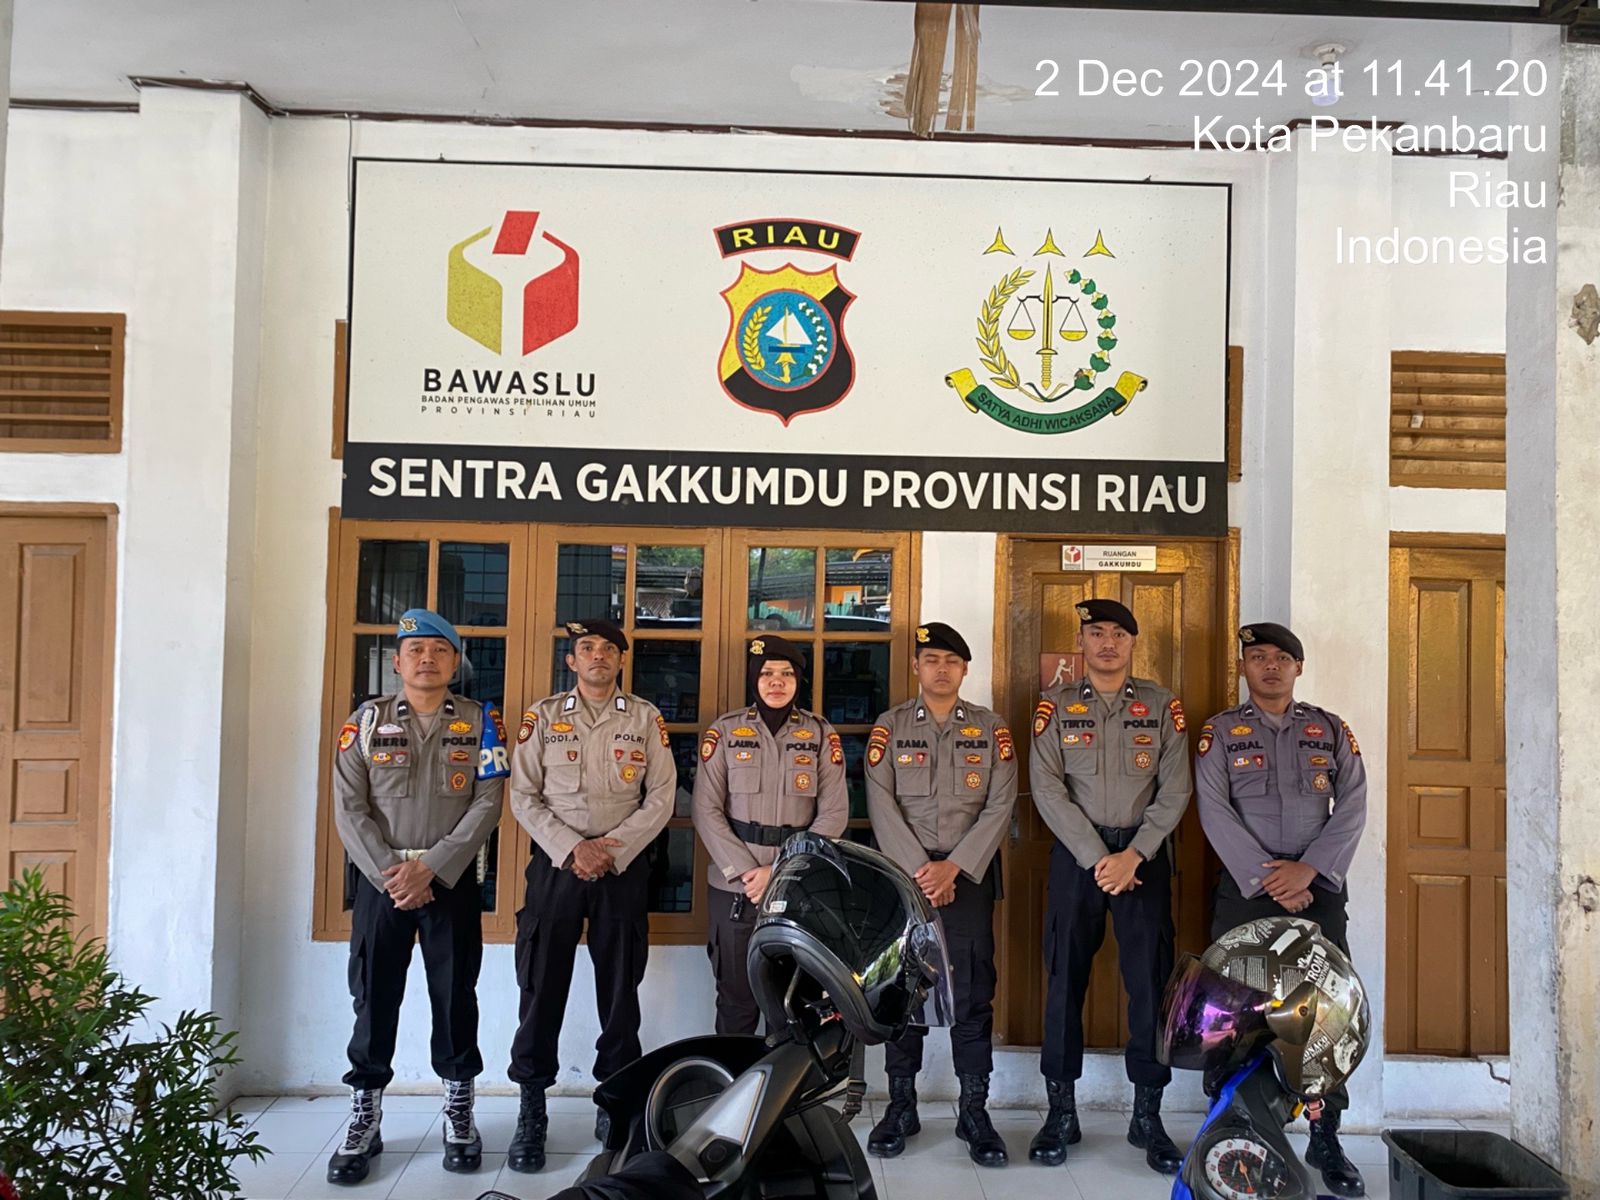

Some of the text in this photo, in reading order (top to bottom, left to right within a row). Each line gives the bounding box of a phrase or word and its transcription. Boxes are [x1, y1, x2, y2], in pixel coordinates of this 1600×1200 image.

[732, 225, 840, 249] RIAU
[423, 368, 596, 397] BAWASLU
[421, 395, 596, 408] BADAN PENGAWAS PEMILIHAN UMUM
[421, 406, 596, 418] PROVINSI RIAU
[977, 392, 1116, 430] SATYA ADHI WICAKSANA
[368, 457, 1207, 514] SENTRA GAKKUMDU PROVINSI RIAU
[1123, 719, 1159, 729] POLRI
[442, 736, 477, 746] POLRI
[614, 733, 645, 744] POLRI
[728, 740, 760, 749] LAURA
[897, 740, 928, 749] RAMA
[956, 740, 988, 749] POLRI
[786, 742, 818, 752] POLRI
[1226, 740, 1264, 753] IQBAL
[1299, 740, 1333, 752] POLRI
